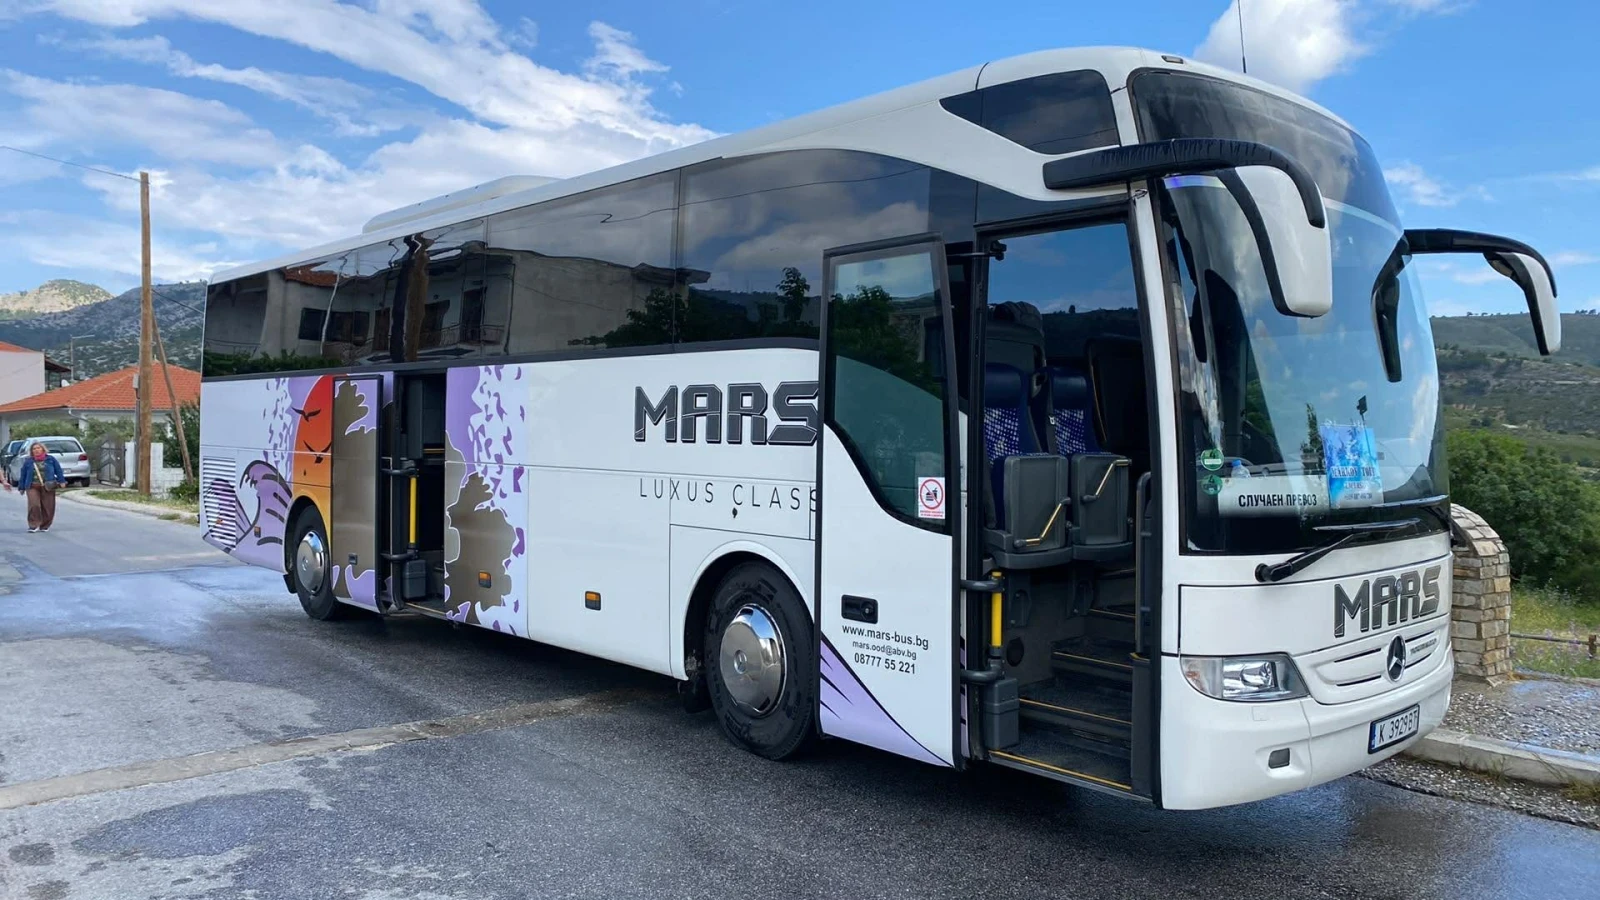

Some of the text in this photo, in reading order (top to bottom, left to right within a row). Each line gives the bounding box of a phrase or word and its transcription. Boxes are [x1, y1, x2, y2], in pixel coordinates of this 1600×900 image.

[634, 381, 818, 446] MARS
[640, 478, 714, 503] LUXUS
[1238, 494, 1318, 507] СЛУЧАЕН ПРЕВОЗ
[1334, 565, 1441, 638] MARS
[842, 625, 929, 650] www.mars-bus.bg
[852, 640, 917, 661] mars.ood@abv.bg
[854, 652, 916, 675] 08777 55 221
[1379, 723, 1386, 743] K
